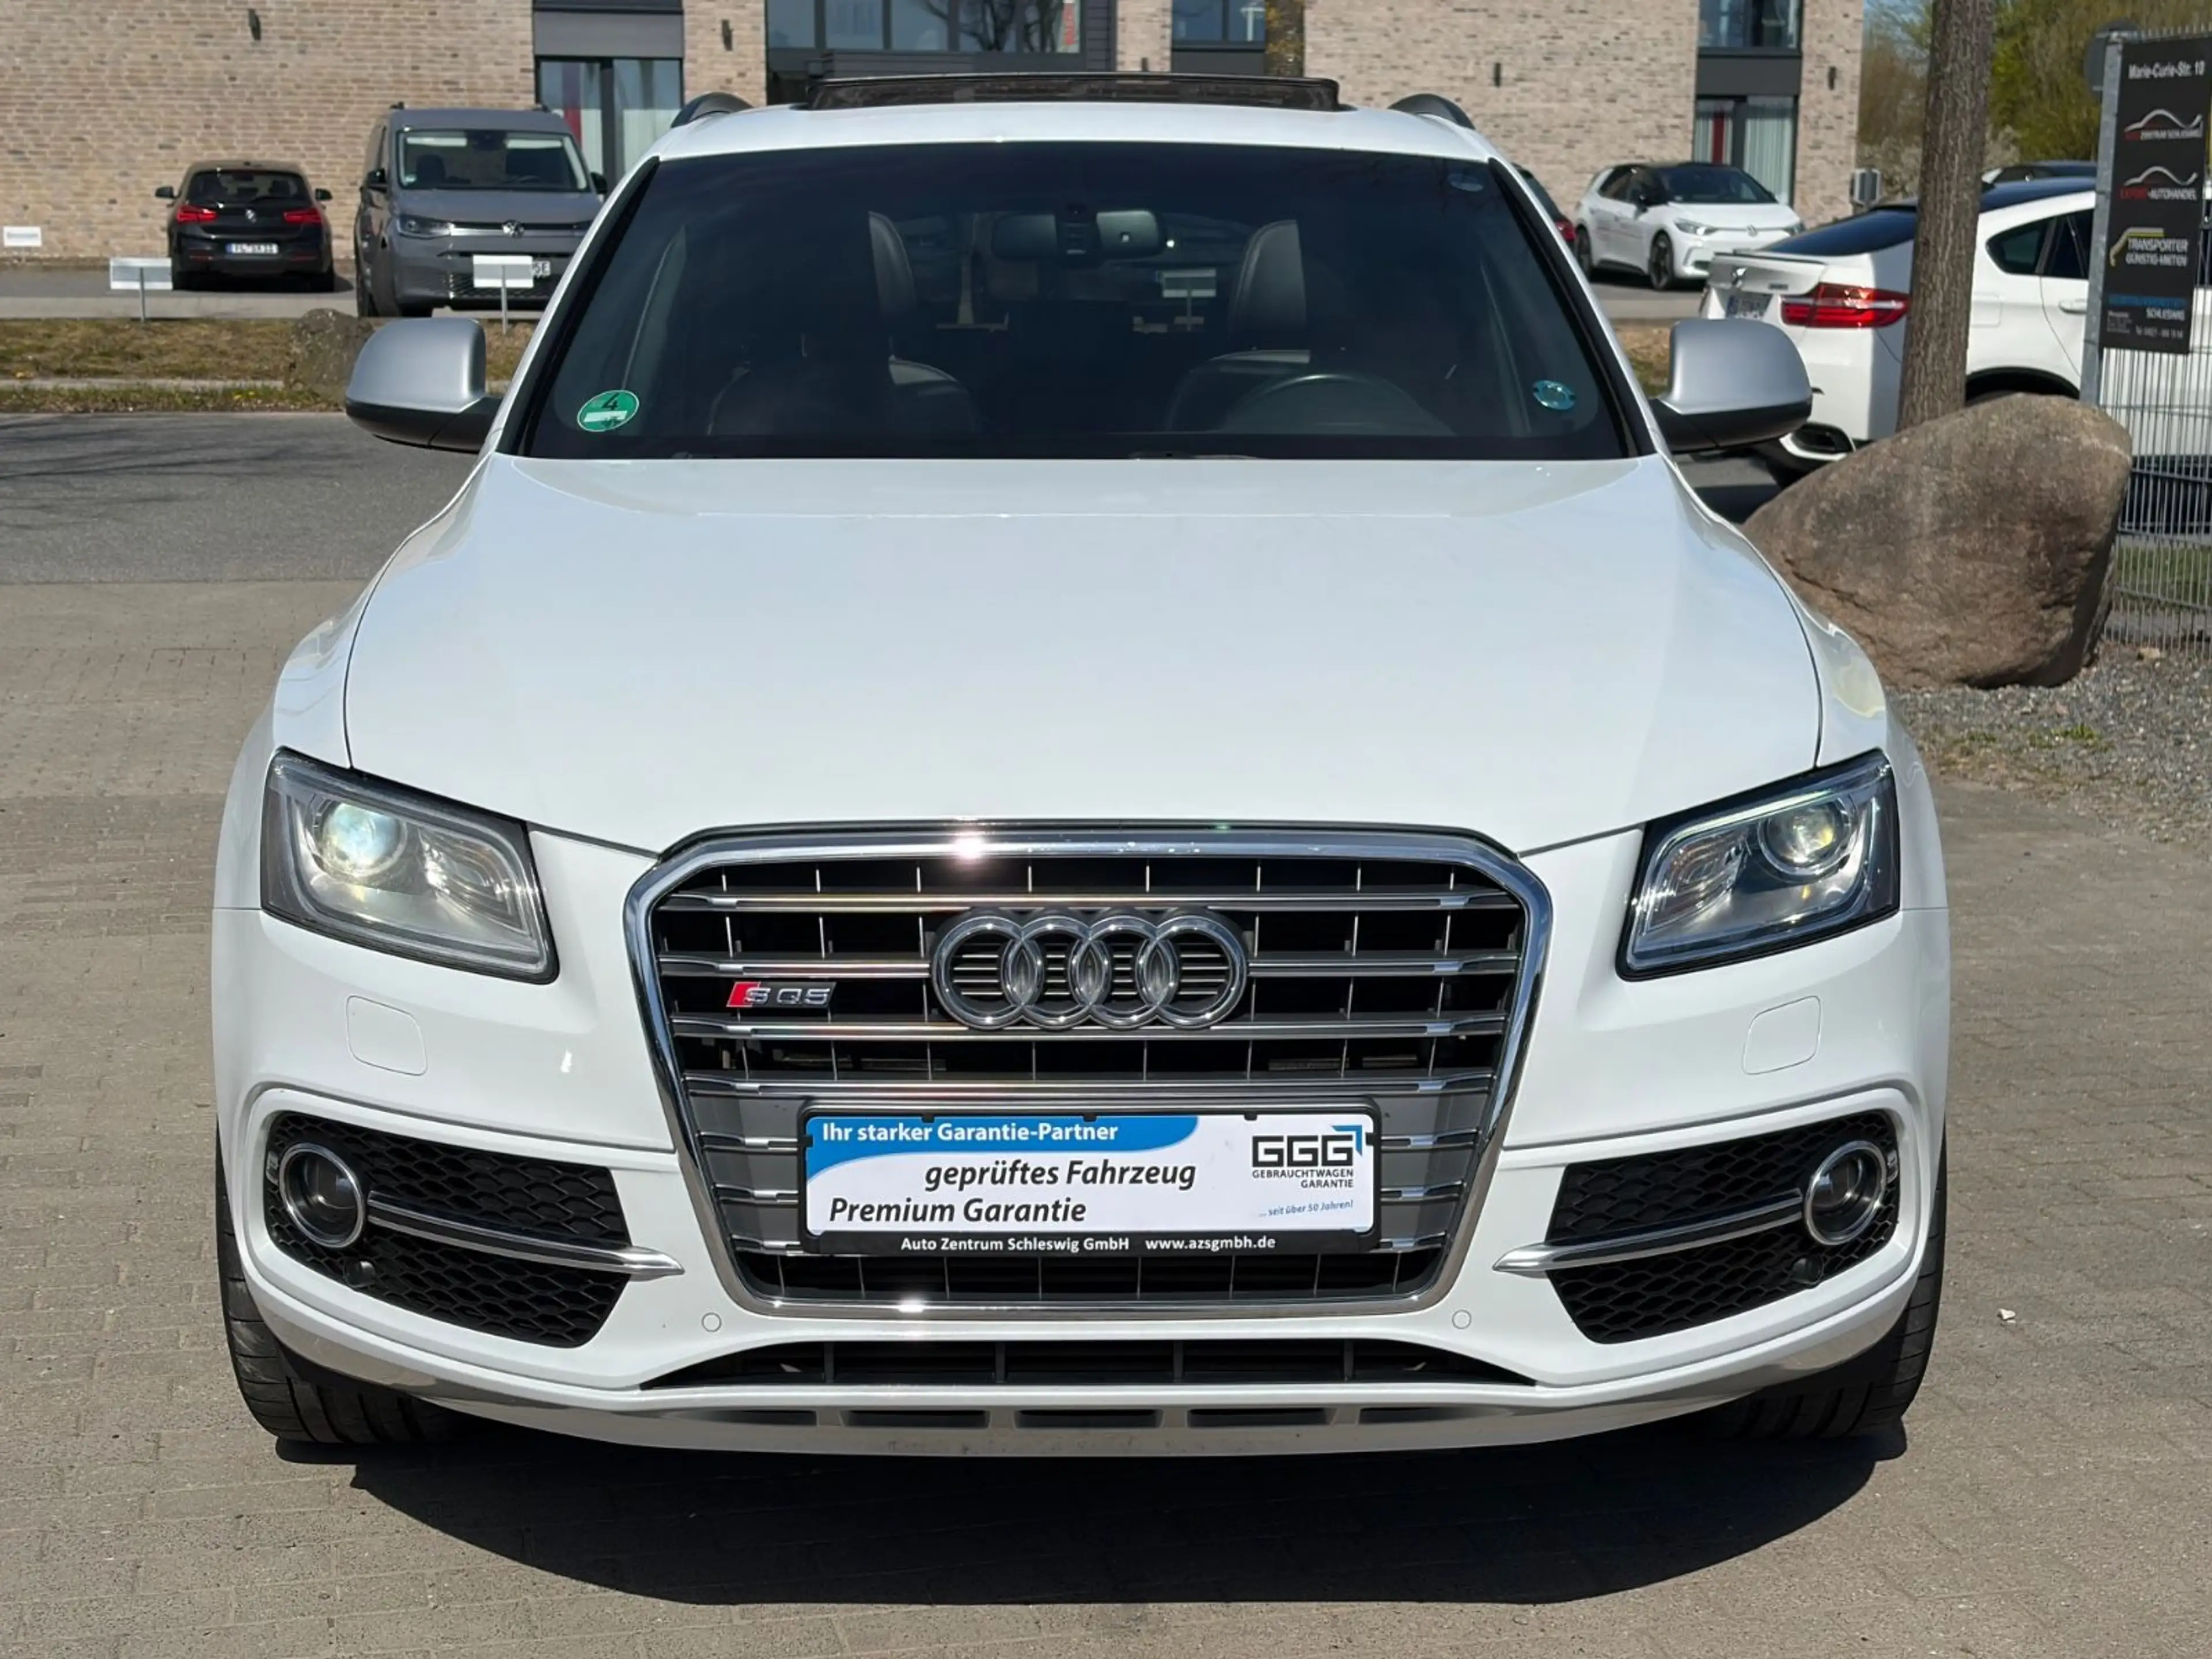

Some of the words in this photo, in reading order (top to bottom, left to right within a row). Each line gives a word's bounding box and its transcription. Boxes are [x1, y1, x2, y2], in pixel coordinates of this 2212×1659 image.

[2128, 60, 2191, 79] Marie-Curie-Str.
[2127, 237, 2188, 253] TRANSPORTER
[601, 392, 620, 410] 4
[744, 988, 831, 1004] SQ5
[823, 1123, 853, 1141] Ihr
[857, 1123, 933, 1141] starker
[937, 1122, 1118, 1141] Garantie-Partner
[1252, 1135, 1353, 1167] GGG
[925, 1160, 1059, 1191] geprüftes
[1066, 1159, 1196, 1191] Fahrzeug
[1252, 1169, 1354, 1179] GEBRAUCHTWAGEN
[1301, 1179, 1354, 1188] GARANTIE
[829, 1197, 955, 1222] Premium
[963, 1197, 1087, 1222] Garantie
[1268, 1206, 1283, 1216] seit
[1286, 1204, 1306, 1214] über
[1307, 1203, 1319, 1212] 50
[1320, 1198, 1354, 1211] Jahren!
[901, 1237, 937, 1250] Auto
[941, 1237, 1003, 1250] Zentrum
[1007, 1237, 1080, 1253] Schleswig
[1084, 1237, 1130, 1250] GmbH
[1145, 1236, 1276, 1252] www.azsgmbh.de
